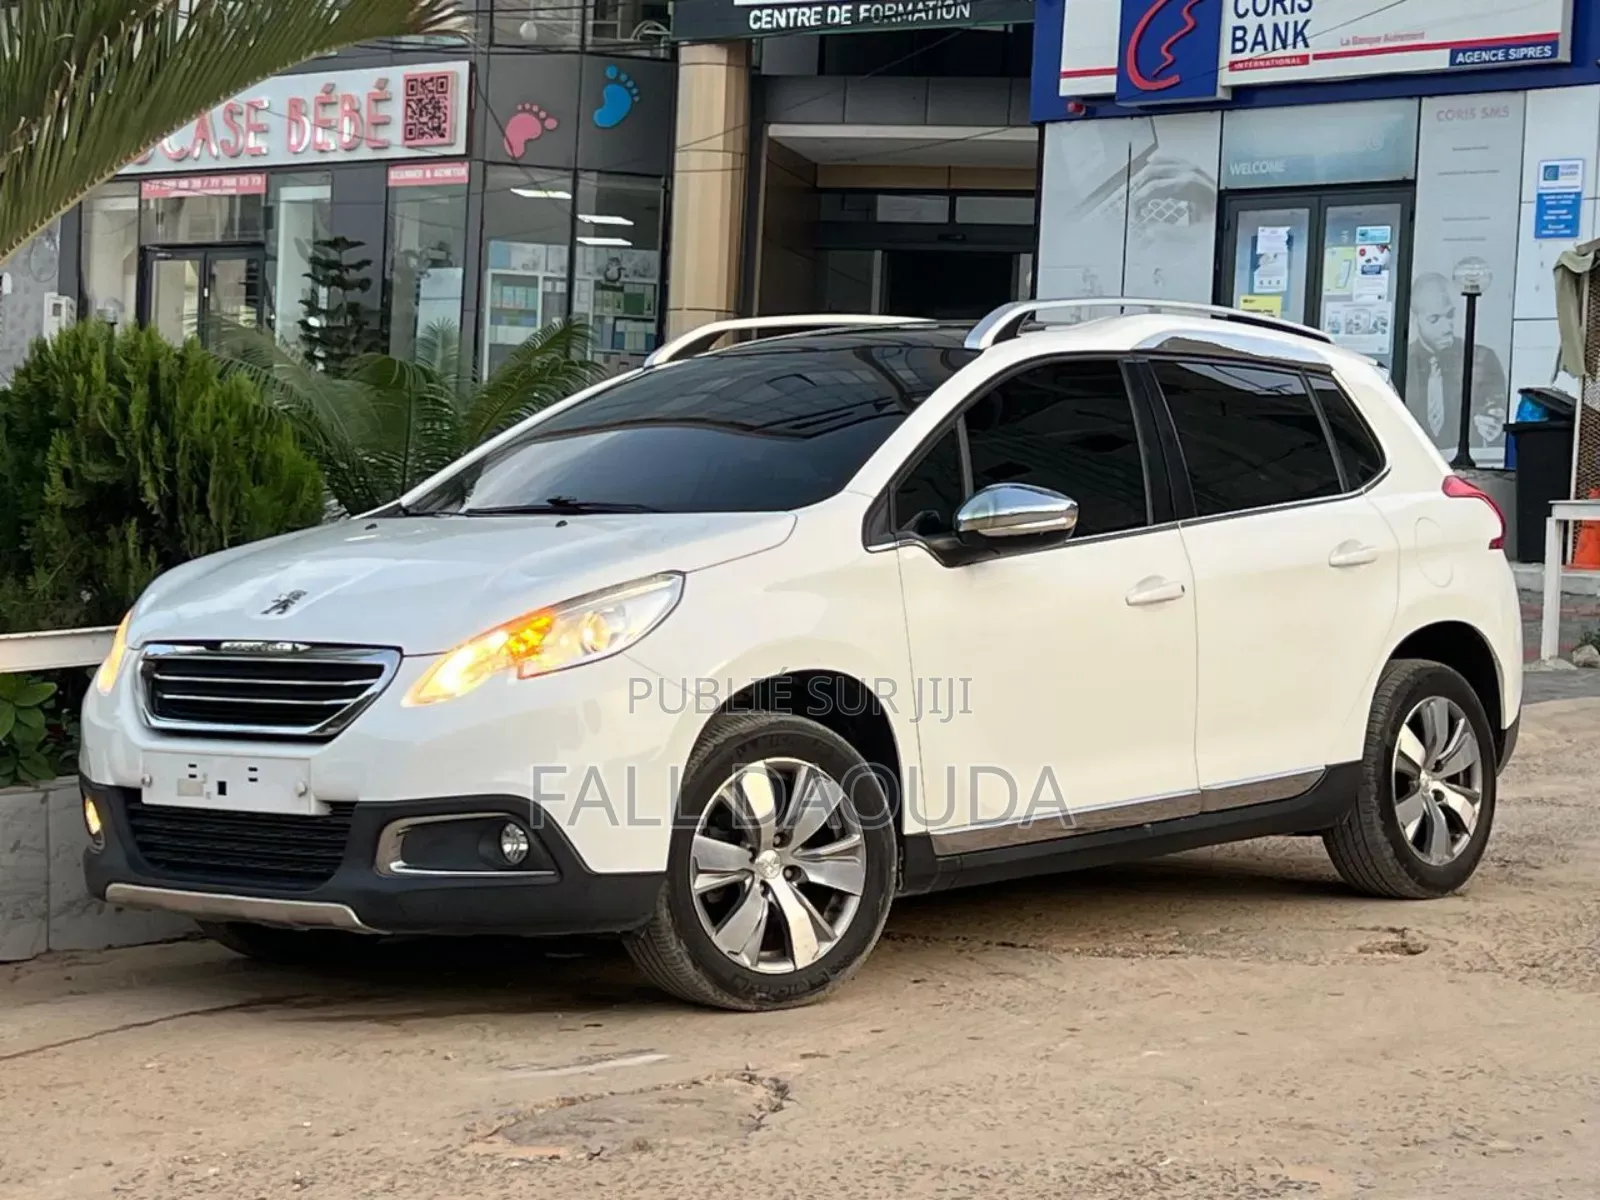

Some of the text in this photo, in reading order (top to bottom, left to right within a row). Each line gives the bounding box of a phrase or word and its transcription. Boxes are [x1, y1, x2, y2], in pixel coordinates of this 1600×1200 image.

[749, 0, 971, 30] CENTRE DE FORMATION
[1231, 20, 1311, 54] BANK
[1233, 57, 1303, 70] INTERNATIONAL
[1456, 45, 1553, 64] AGENCE SIPRES
[287, 77, 393, 154] BÉBÉ
[1436, 105, 1510, 122] CORIS SMS
[1230, 159, 1286, 177] WELCOME
